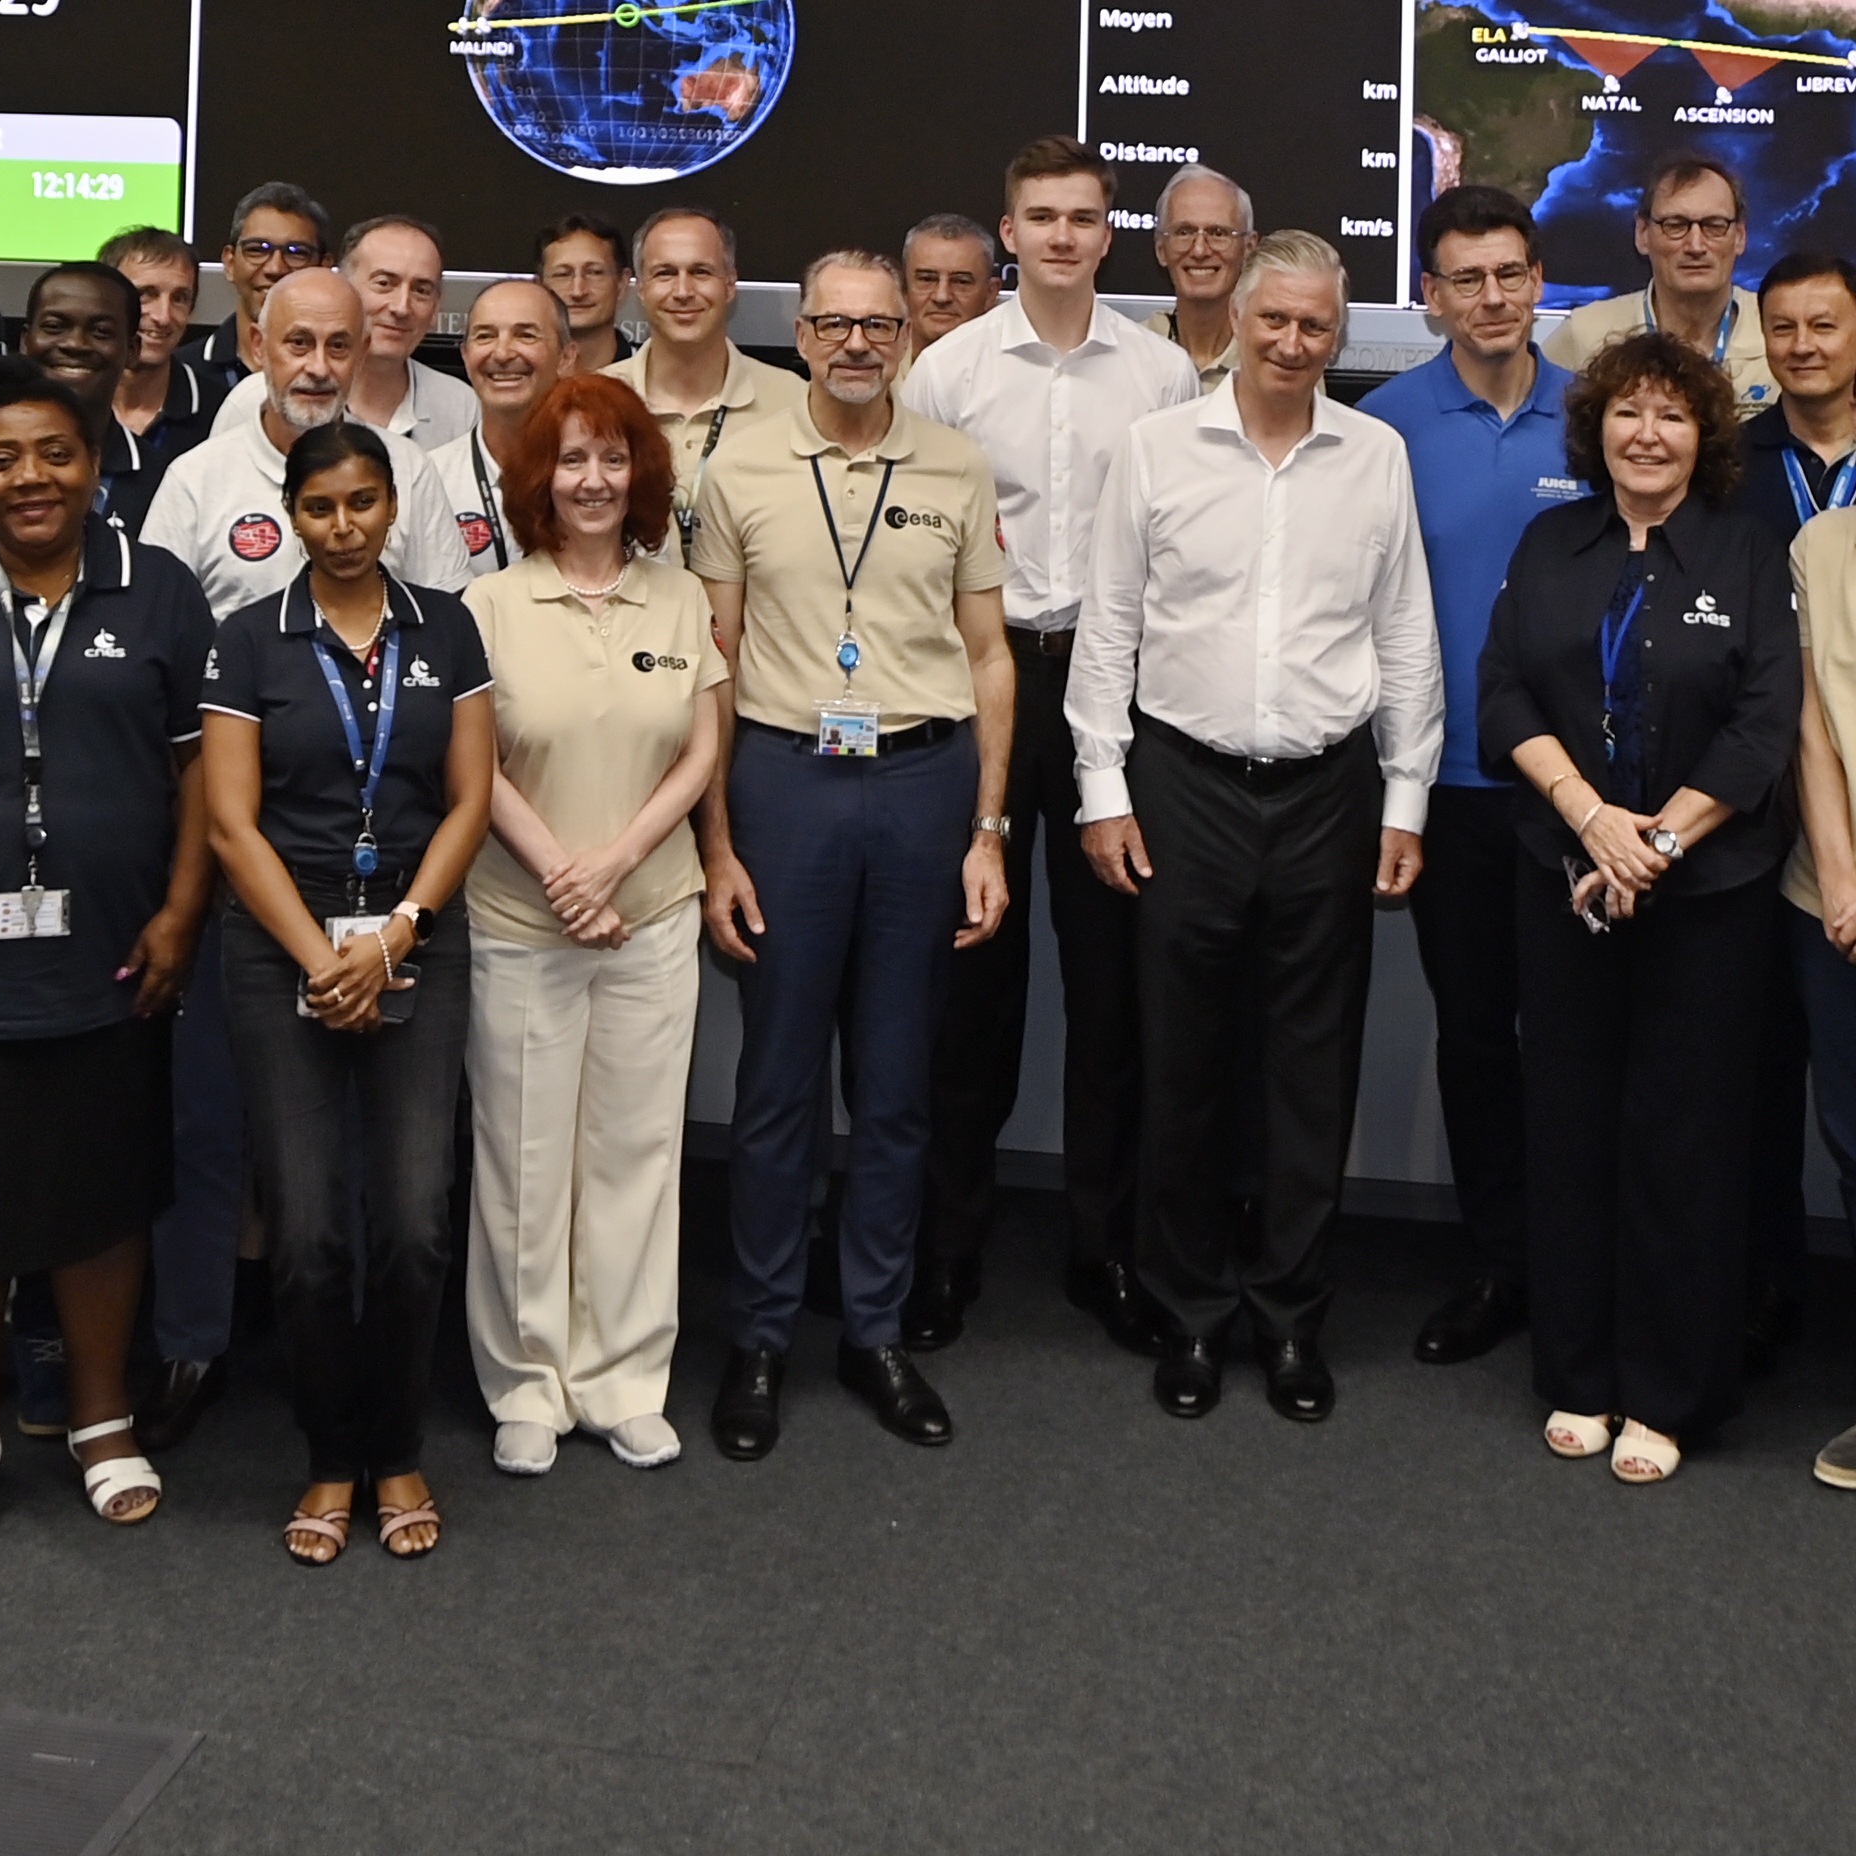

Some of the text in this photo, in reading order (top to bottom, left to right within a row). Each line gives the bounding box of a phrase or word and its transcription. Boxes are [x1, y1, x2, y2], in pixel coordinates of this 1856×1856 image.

[1100, 9, 1172, 31] Moyen
[1472, 26, 1506, 43] ELA
[450, 40, 514, 57] MALINDI
[1475, 48, 1548, 64] GALLIOT
[1100, 76, 1397, 99] Altitude km
[1581, 97, 1642, 113] NATAL
[1674, 107, 1773, 124] ASCENSION
[1100, 143, 1396, 167] Distance km
[32, 172, 124, 200] 12:14:29
[1341, 217, 1393, 236] km/s
